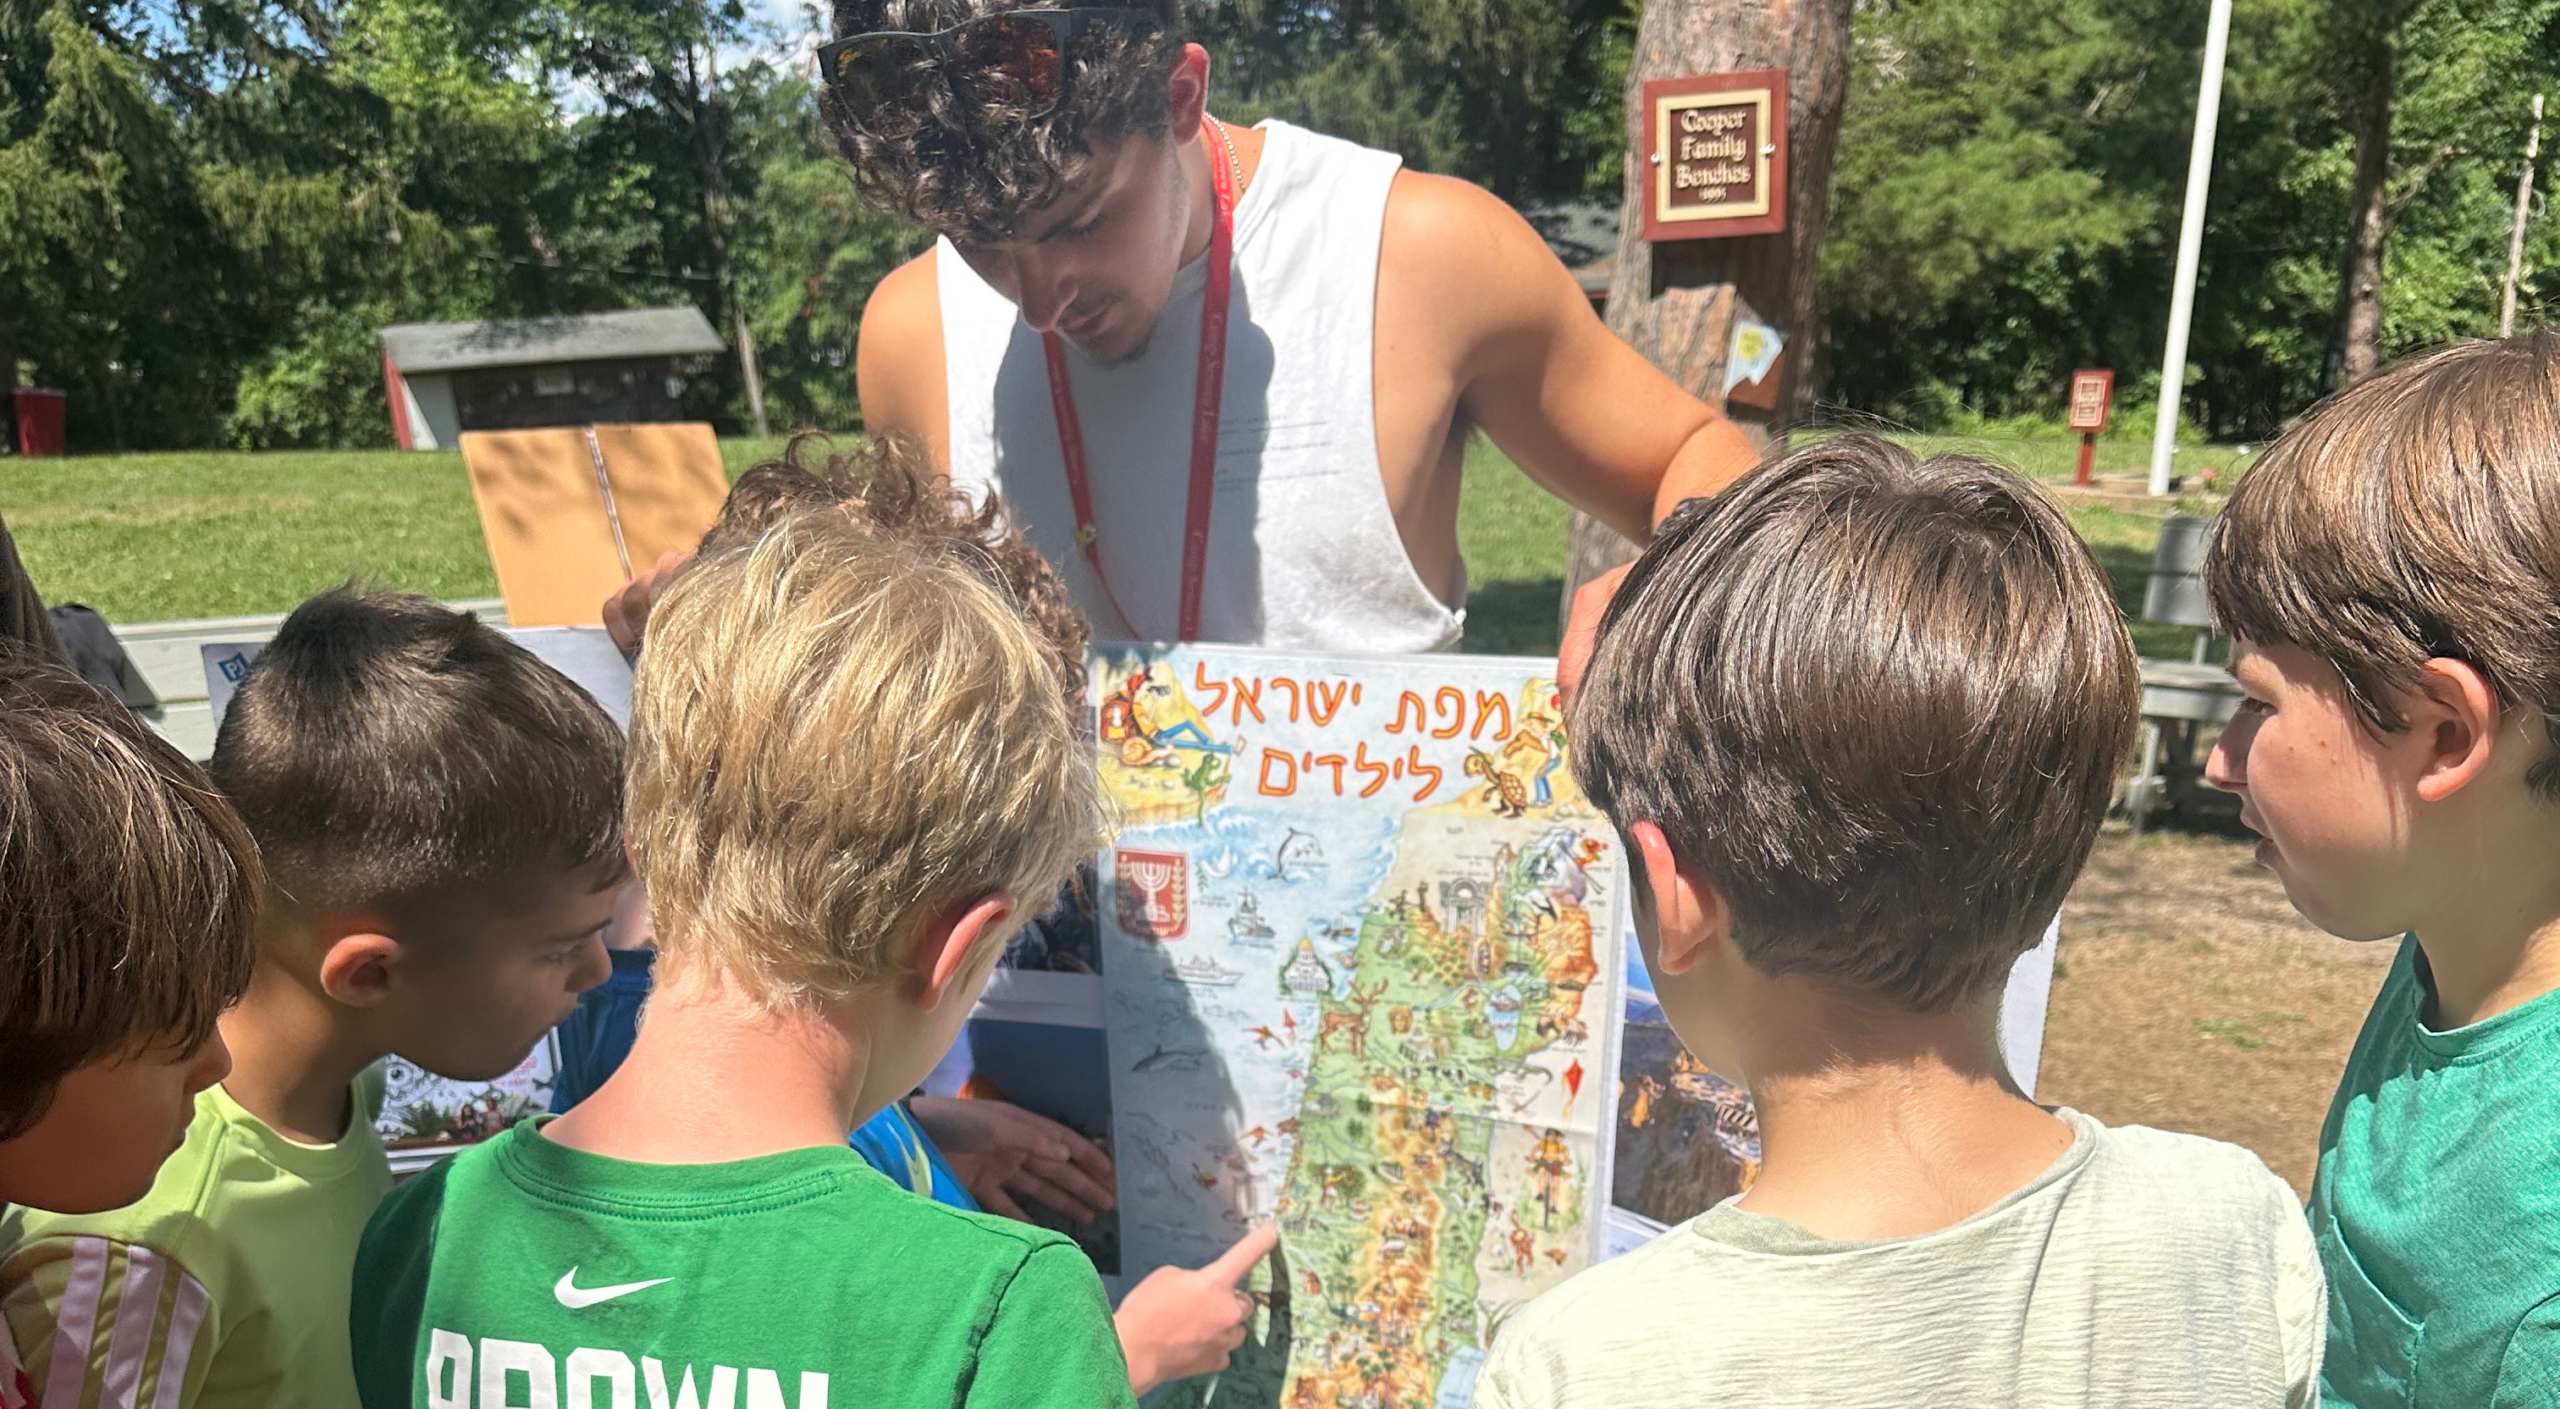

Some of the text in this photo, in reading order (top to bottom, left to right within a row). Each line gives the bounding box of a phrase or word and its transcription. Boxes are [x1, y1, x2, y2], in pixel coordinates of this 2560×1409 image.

[1680, 109, 1747, 136] Cooper
[1680, 134, 1747, 162] Family
[1675, 160, 1752, 189] Benches
[1195, 660, 1513, 741] מפת ישראל
[1258, 740, 1444, 802] לילדים
